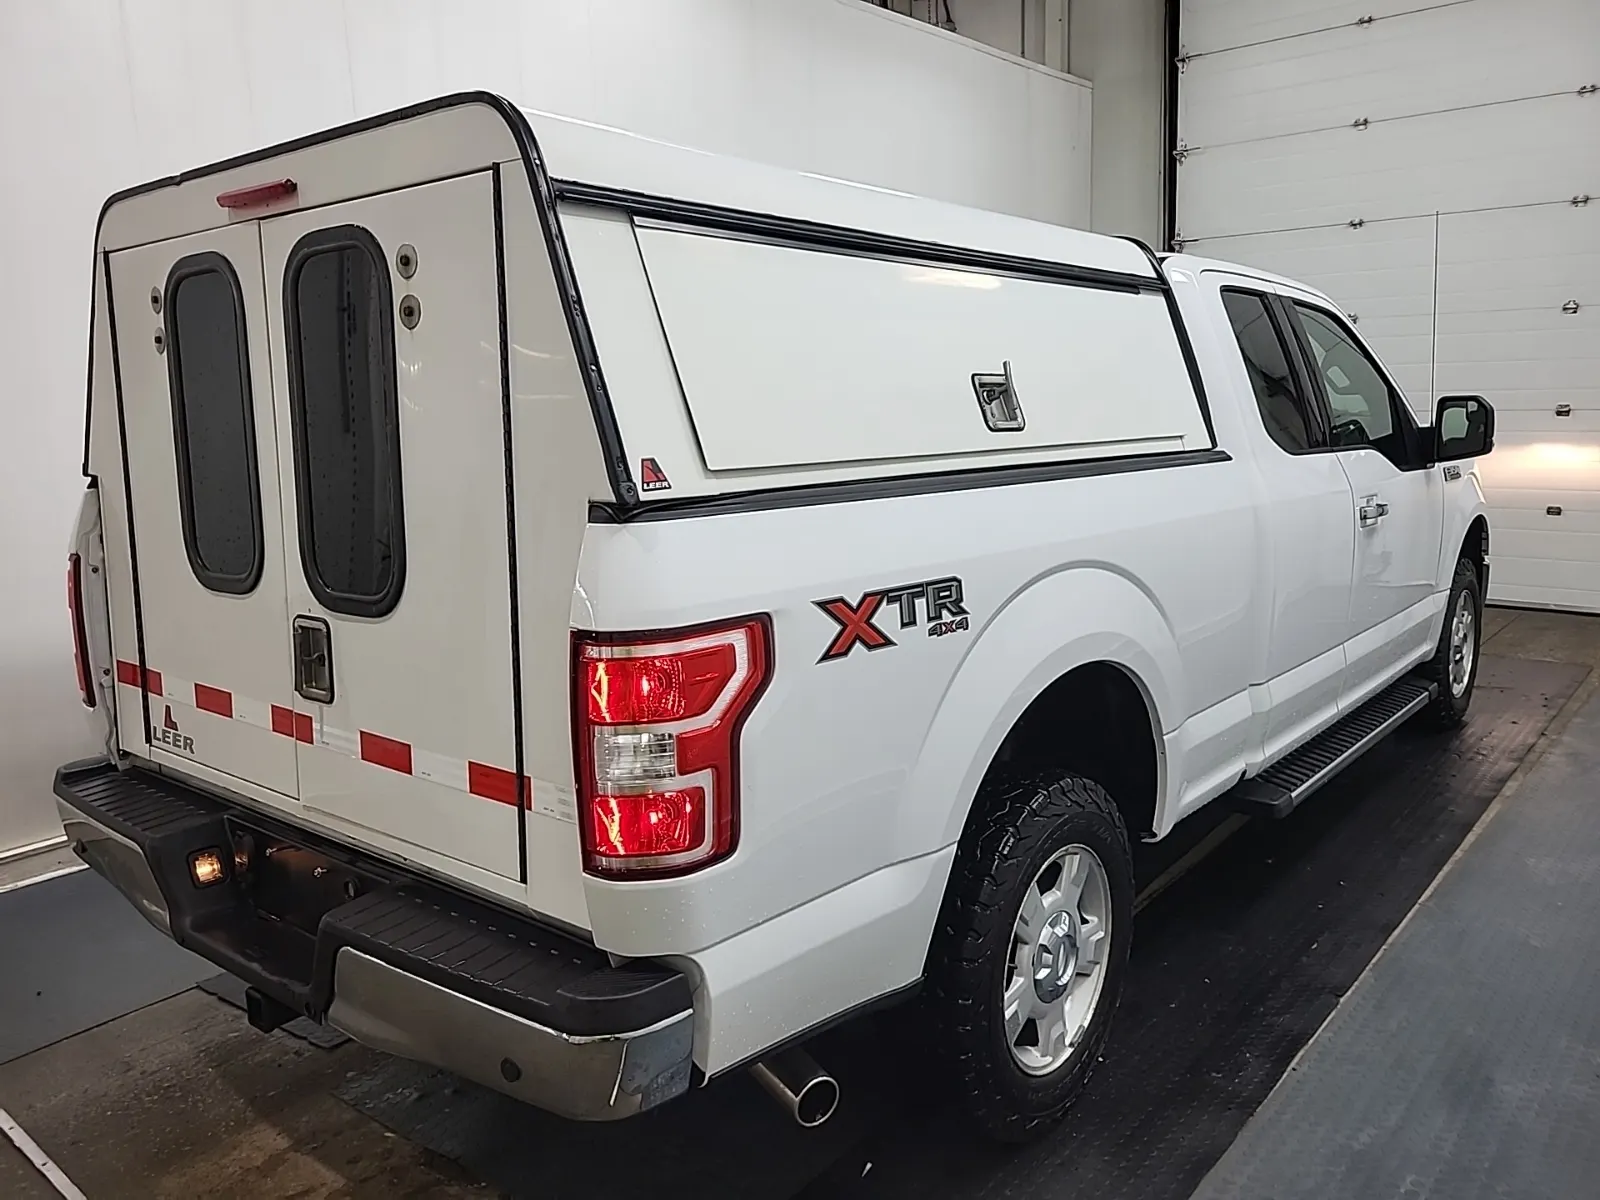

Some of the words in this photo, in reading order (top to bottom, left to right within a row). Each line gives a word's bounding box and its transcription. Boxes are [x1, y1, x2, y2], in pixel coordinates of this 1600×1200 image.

[643, 481, 669, 490] LEER
[811, 575, 970, 665] XTR
[152, 725, 195, 754] LEER
